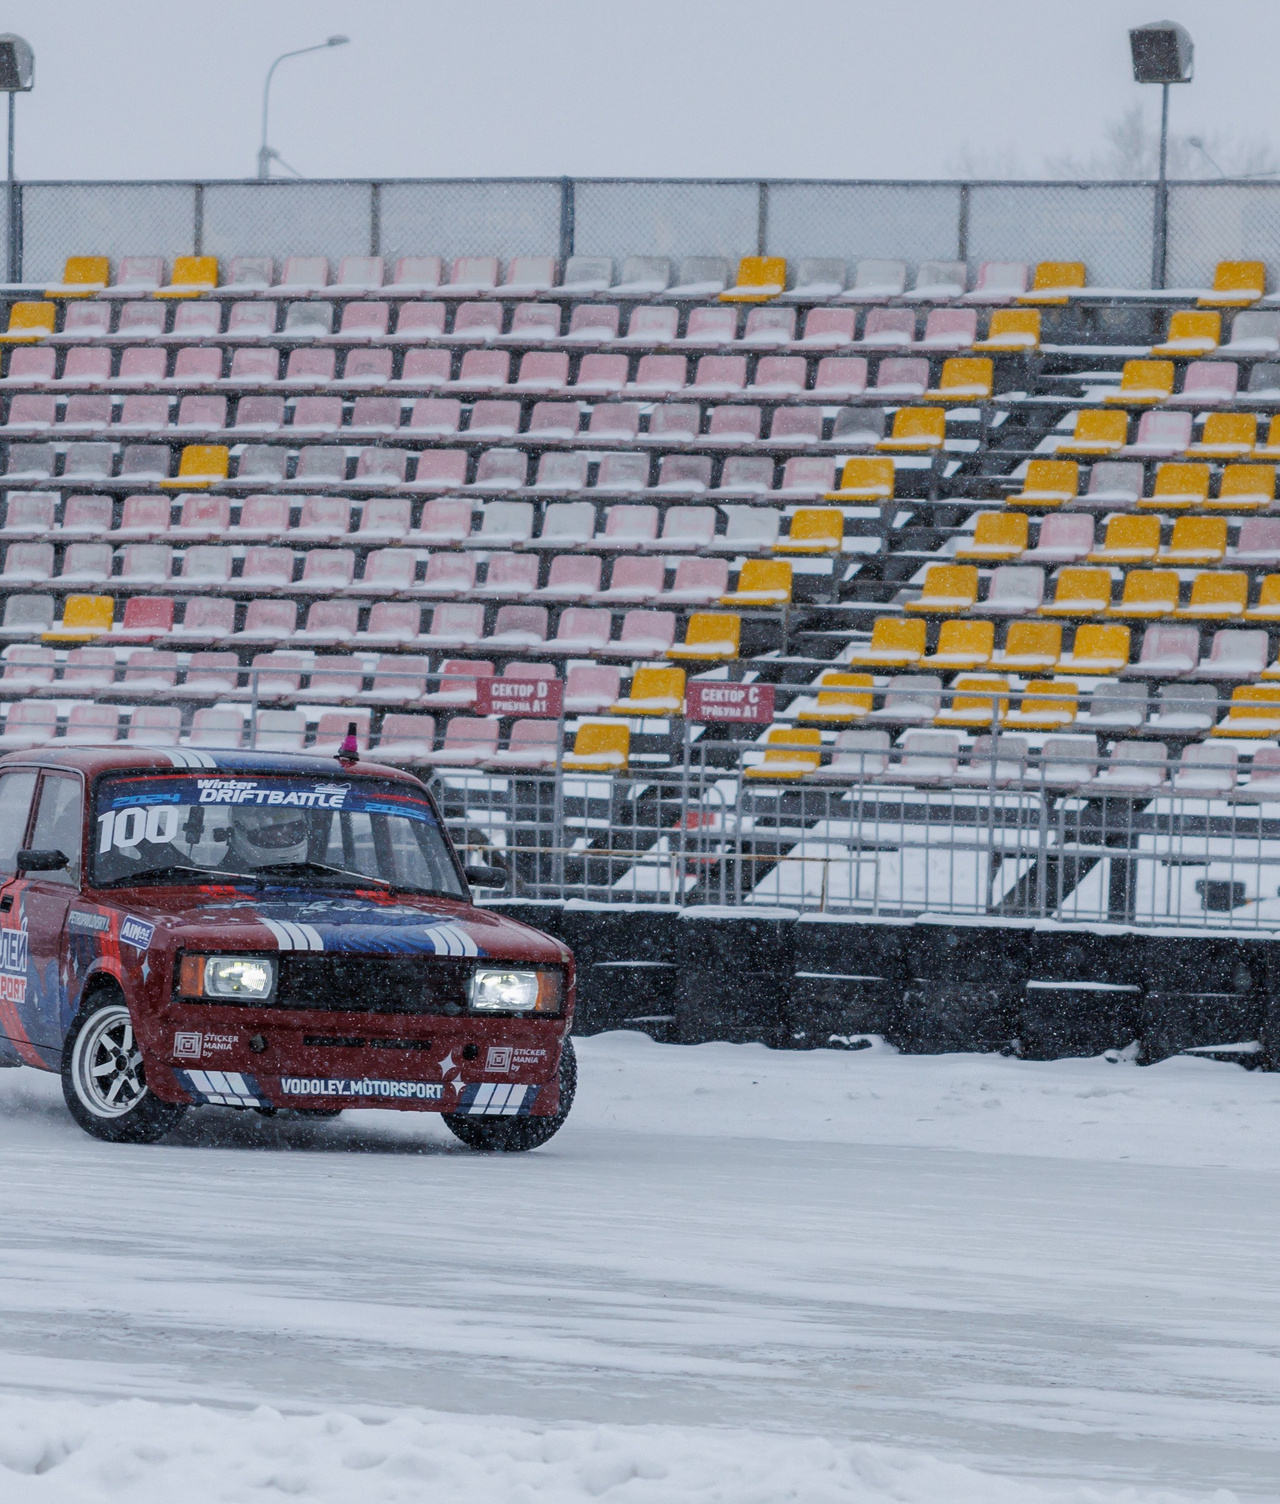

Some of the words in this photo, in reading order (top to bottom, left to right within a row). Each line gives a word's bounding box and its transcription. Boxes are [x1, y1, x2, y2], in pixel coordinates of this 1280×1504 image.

[492, 683, 534, 697] СЕКТОР
[701, 688, 745, 702] СЕКТОР
[492, 700, 531, 711] ТРИБУНА
[701, 706, 741, 717] ТРИБУНА
[197, 779, 258, 790] Winter
[111, 794, 181, 808] 2024
[198, 788, 346, 808] DRIFTBATTLE
[364, 802, 427, 820] 2025
[97, 805, 180, 855] 100
[203, 1034, 239, 1043] STICKER
[203, 1042, 232, 1050] MANIA
[202, 1050, 213, 1058] by
[513, 1048, 547, 1056] STICKER
[511, 1063, 520, 1072] by
[281, 1077, 443, 1099] VODOLEY_MOTORSPORT
